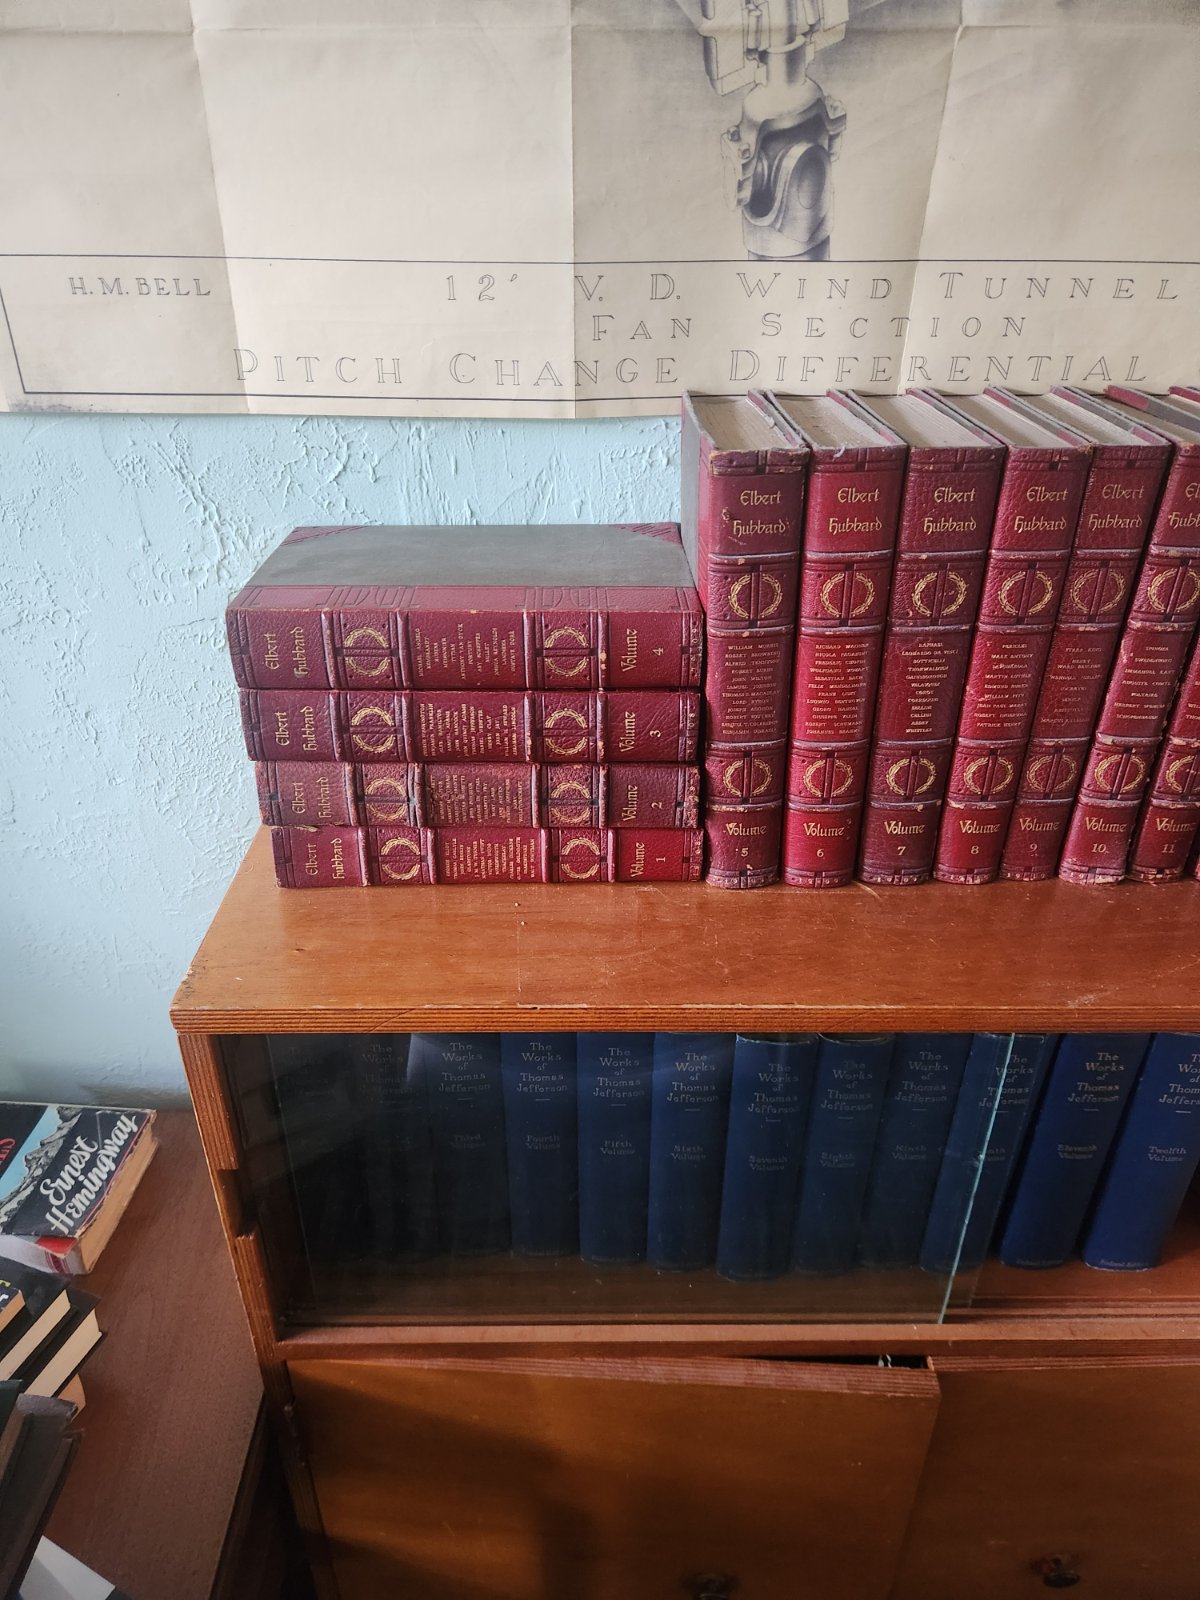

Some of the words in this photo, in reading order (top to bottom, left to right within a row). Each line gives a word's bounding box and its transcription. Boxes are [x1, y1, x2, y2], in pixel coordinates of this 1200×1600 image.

[650, 273, 682, 300] D.
[736, 272, 891, 300] WIND
[939, 272, 1179, 300] TUNNEL
[592, 315, 692, 341] FAN
[761, 312, 1025, 339] SECTION
[233, 348, 402, 384] PITCH
[448, 352, 678, 386] CHANGE
[729, 349, 1148, 384] DIFFERENTIAL
[838, 488, 880, 503] Elbert
[934, 487, 976, 503] Elbert
[1027, 487, 1068, 501] Elbert
[1102, 483, 1145, 499] Elbert
[740, 490, 781, 506] Elbert
[829, 516, 882, 535] Hubbard
[924, 516, 976, 534] Hubbard
[1014, 516, 1067, 533] Hubbard
[1088, 514, 1142, 531] Hubbard
[733, 519, 786, 537] Hubbard
[264, 632, 279, 670] Elbert
[292, 626, 310, 675] Hubbard
[620, 628, 638, 671] Volume
[652, 648, 664, 656] 4
[275, 712, 289, 745] Elbert
[301, 706, 317, 751] Hubbard
[620, 712, 636, 752] Volume
[650, 730, 660, 738] 3
[292, 782, 305, 814] Elbert
[318, 776, 332, 818] Hubbard
[622, 785, 638, 821] Volume
[884, 821, 925, 835] Volume
[959, 820, 1000, 834] Volume
[1019, 818, 1059, 832] Volume
[1085, 816, 1127, 832] Volume
[725, 823, 767, 836] Volume
[803, 823, 845, 836] Volume
[741, 848, 749, 857] 5
[897, 846, 906, 856] 7
[970, 845, 979, 855] 8
[1030, 843, 1038, 852] 9
[1091, 843, 1107, 853] 10
[1162, 844, 1175, 853] 11
[332, 838, 345, 879] Hubbard
[817, 849, 824, 858] 6
[305, 843, 318, 875] Elbert
[630, 842, 645, 877] Volume
[450, 1042, 472, 1050] The
[530, 1042, 551, 1050] The
[442, 1052, 482, 1062] Works
[608, 1048, 630, 1056] The
[685, 1053, 707, 1061] The
[920, 1052, 942, 1060] The
[1097, 1052, 1119, 1062] The
[521, 1053, 561, 1062] Works
[600, 1058, 640, 1067] Works
[675, 1062, 715, 1072] Works
[769, 1063, 791, 1071] The
[845, 1060, 865, 1069] The
[908, 1061, 949, 1071] Works
[1085, 1062, 1124, 1072] Works
[442, 1072, 486, 1081] Thomas
[520, 1072, 564, 1082] Thomas
[614, 1068, 624, 1076] of
[833, 1069, 872, 1079] Works
[597, 1077, 640, 1086] Thomas
[758, 1073, 799, 1083] Works
[439, 1082, 490, 1092] Jefferson
[516, 1082, 568, 1092] Jefferson
[672, 1082, 715, 1091] Thomas
[902, 1081, 946, 1091] Thomas
[1077, 1082, 1120, 1092] Thomas
[593, 1088, 644, 1098] Jefferson
[667, 1092, 718, 1103] Jefferson
[754, 1092, 798, 1102] Thomas
[828, 1089, 871, 1099] Thomas
[894, 1092, 947, 1102] Jefferson
[1068, 1093, 1119, 1102] Jefferson
[748, 1103, 799, 1113] Jefferson
[820, 1100, 873, 1110] Jefferson
[40, 1136, 98, 1206] Ernest
[45, 1114, 139, 1235] Hemingway
